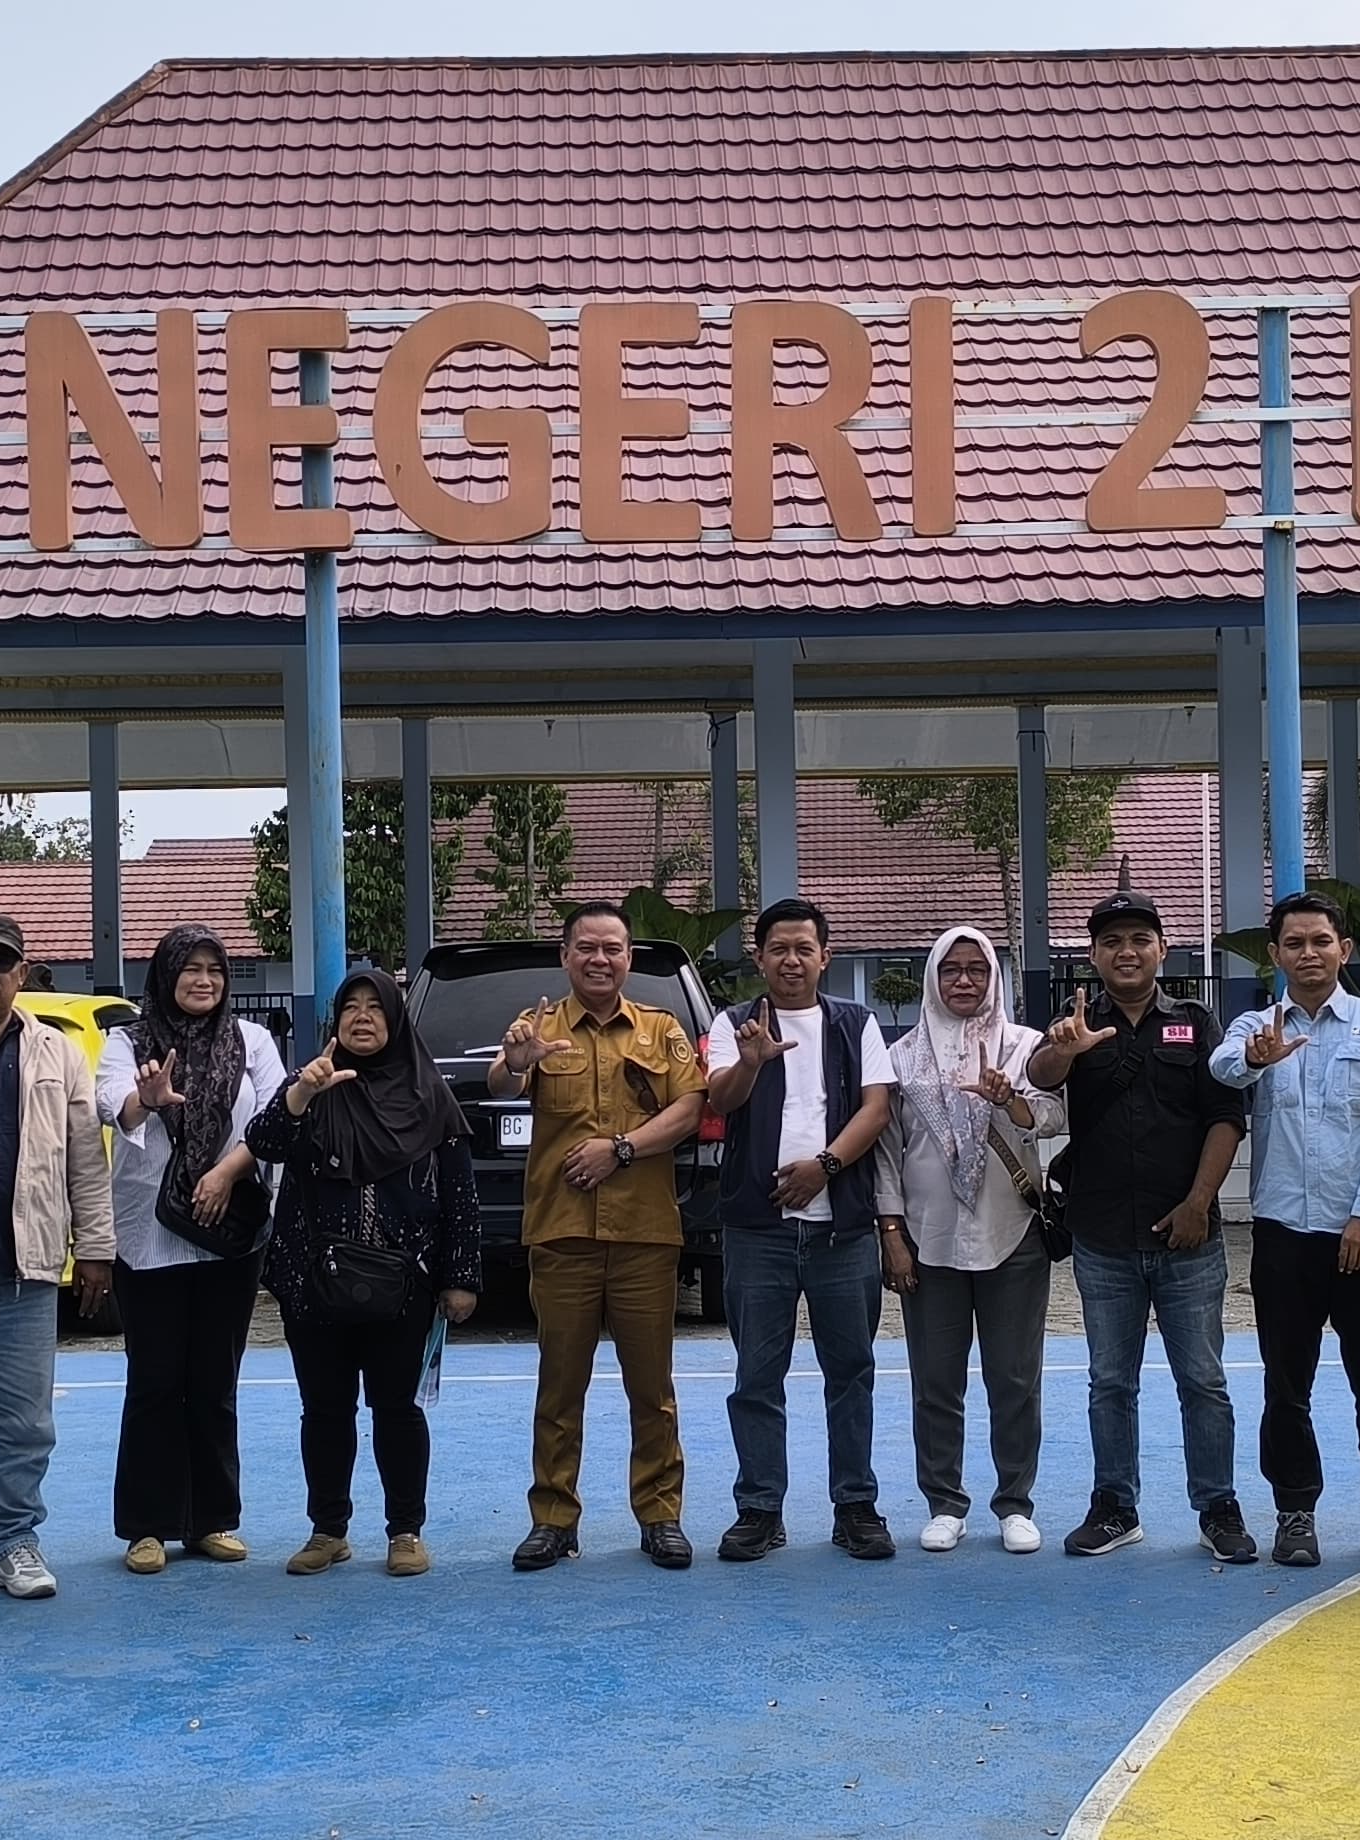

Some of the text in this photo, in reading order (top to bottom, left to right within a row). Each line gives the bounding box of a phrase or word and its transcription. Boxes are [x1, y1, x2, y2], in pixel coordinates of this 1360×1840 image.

[24, 296, 957, 552] NEGERI
[1078, 290, 1227, 534] 2
[503, 1117, 522, 1136] BG
